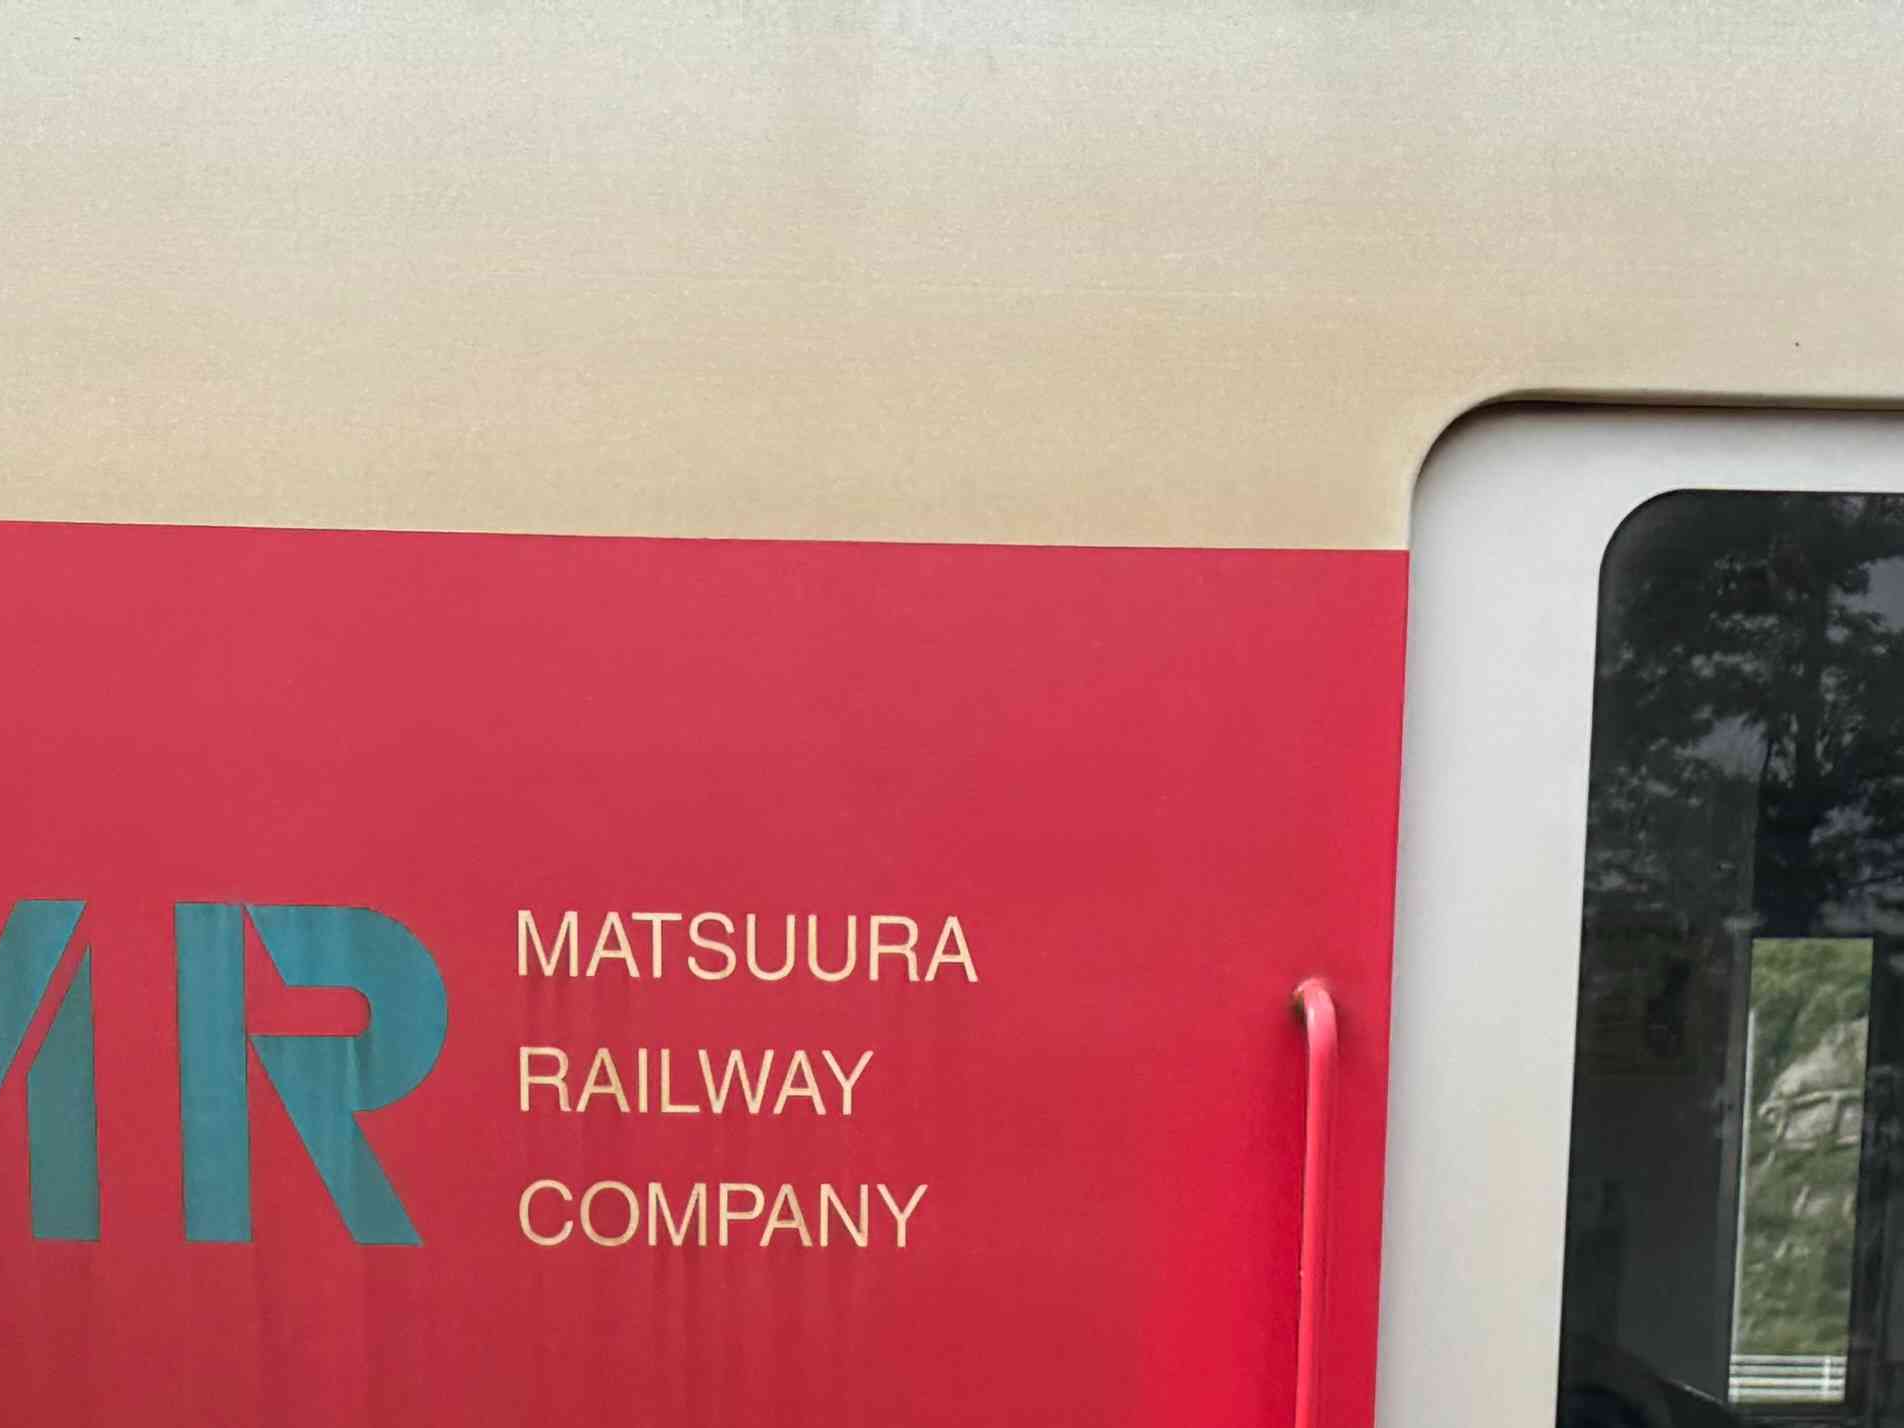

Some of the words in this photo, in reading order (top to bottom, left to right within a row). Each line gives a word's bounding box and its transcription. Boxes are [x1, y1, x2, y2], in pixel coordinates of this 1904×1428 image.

[517, 909, 978, 982] MATSUURA
[519, 1046, 874, 1116] RAILWAY
[519, 1179, 929, 1248] COMPANY
